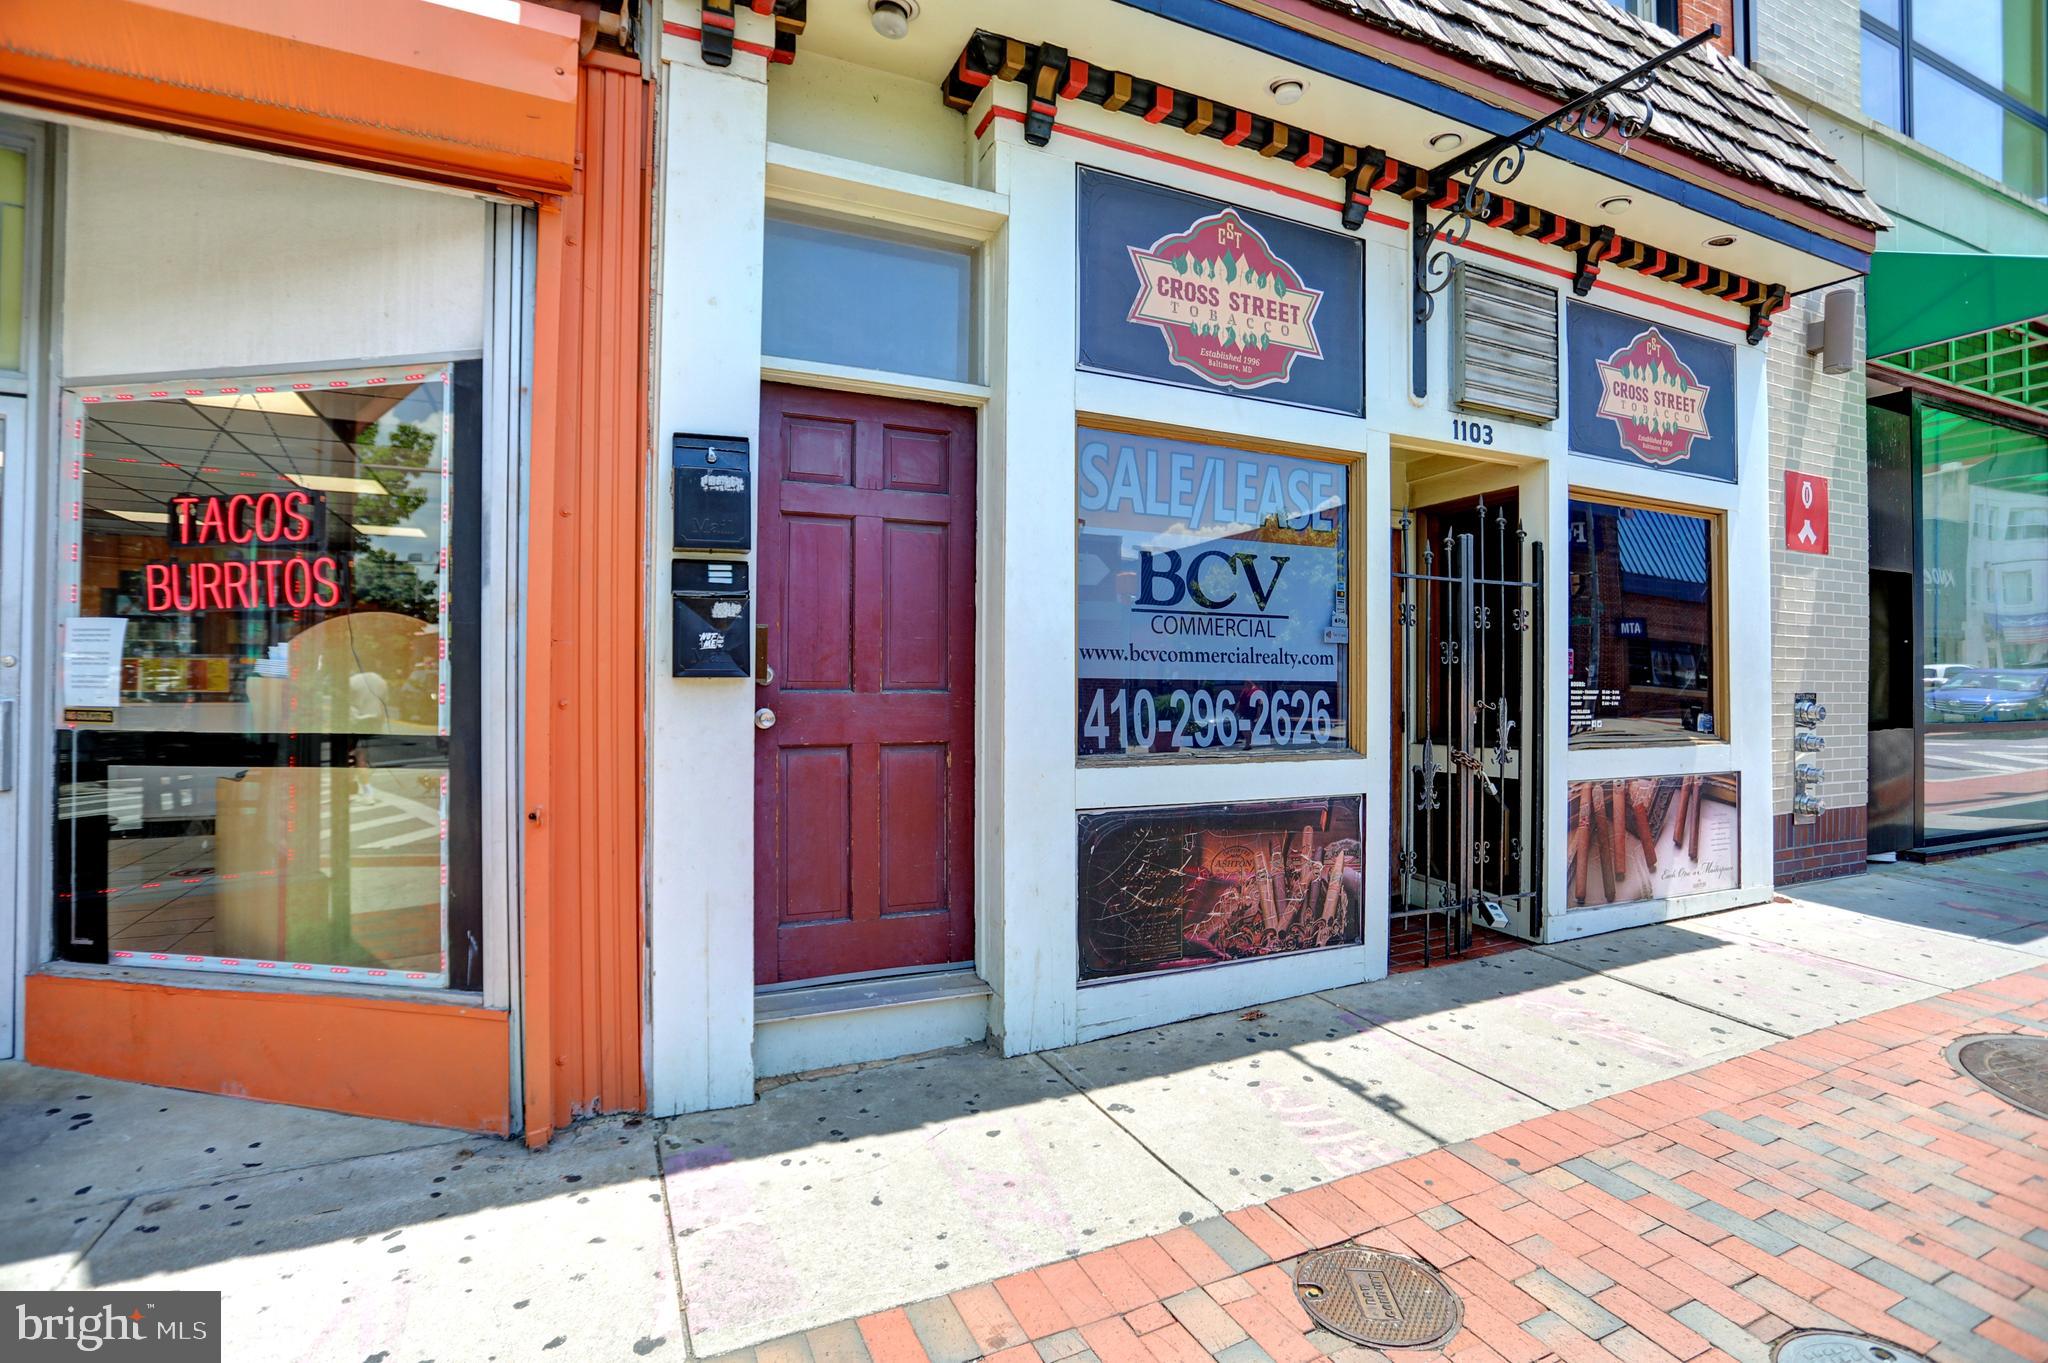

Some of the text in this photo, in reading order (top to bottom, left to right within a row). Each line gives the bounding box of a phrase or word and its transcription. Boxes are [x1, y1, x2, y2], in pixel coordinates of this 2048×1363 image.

[1218, 222, 1242, 249] CST
[1157, 275, 1301, 325] CROSS STREET
[1170, 301, 1290, 337] TOBACCO
[1200, 348, 1261, 367] Established 1996
[1242, 365, 1253, 373] MD
[1613, 381, 1696, 414] CROSS STREET
[1621, 400, 1690, 423] TOBACCO
[1453, 419, 1493, 445] 1103
[1078, 440, 1334, 534] SALE/LEASE
[172, 491, 310, 545] TACOS
[146, 556, 341, 611] BURRITOS
[1135, 548, 1290, 612] BCV
[1151, 614, 1276, 639] COMMERCIAL
[1079, 643, 1335, 670] www.bcvcommercialrealty.com
[1083, 688, 1332, 750] 410-296-2626
[1215, 858, 1253, 867] ASHTON
